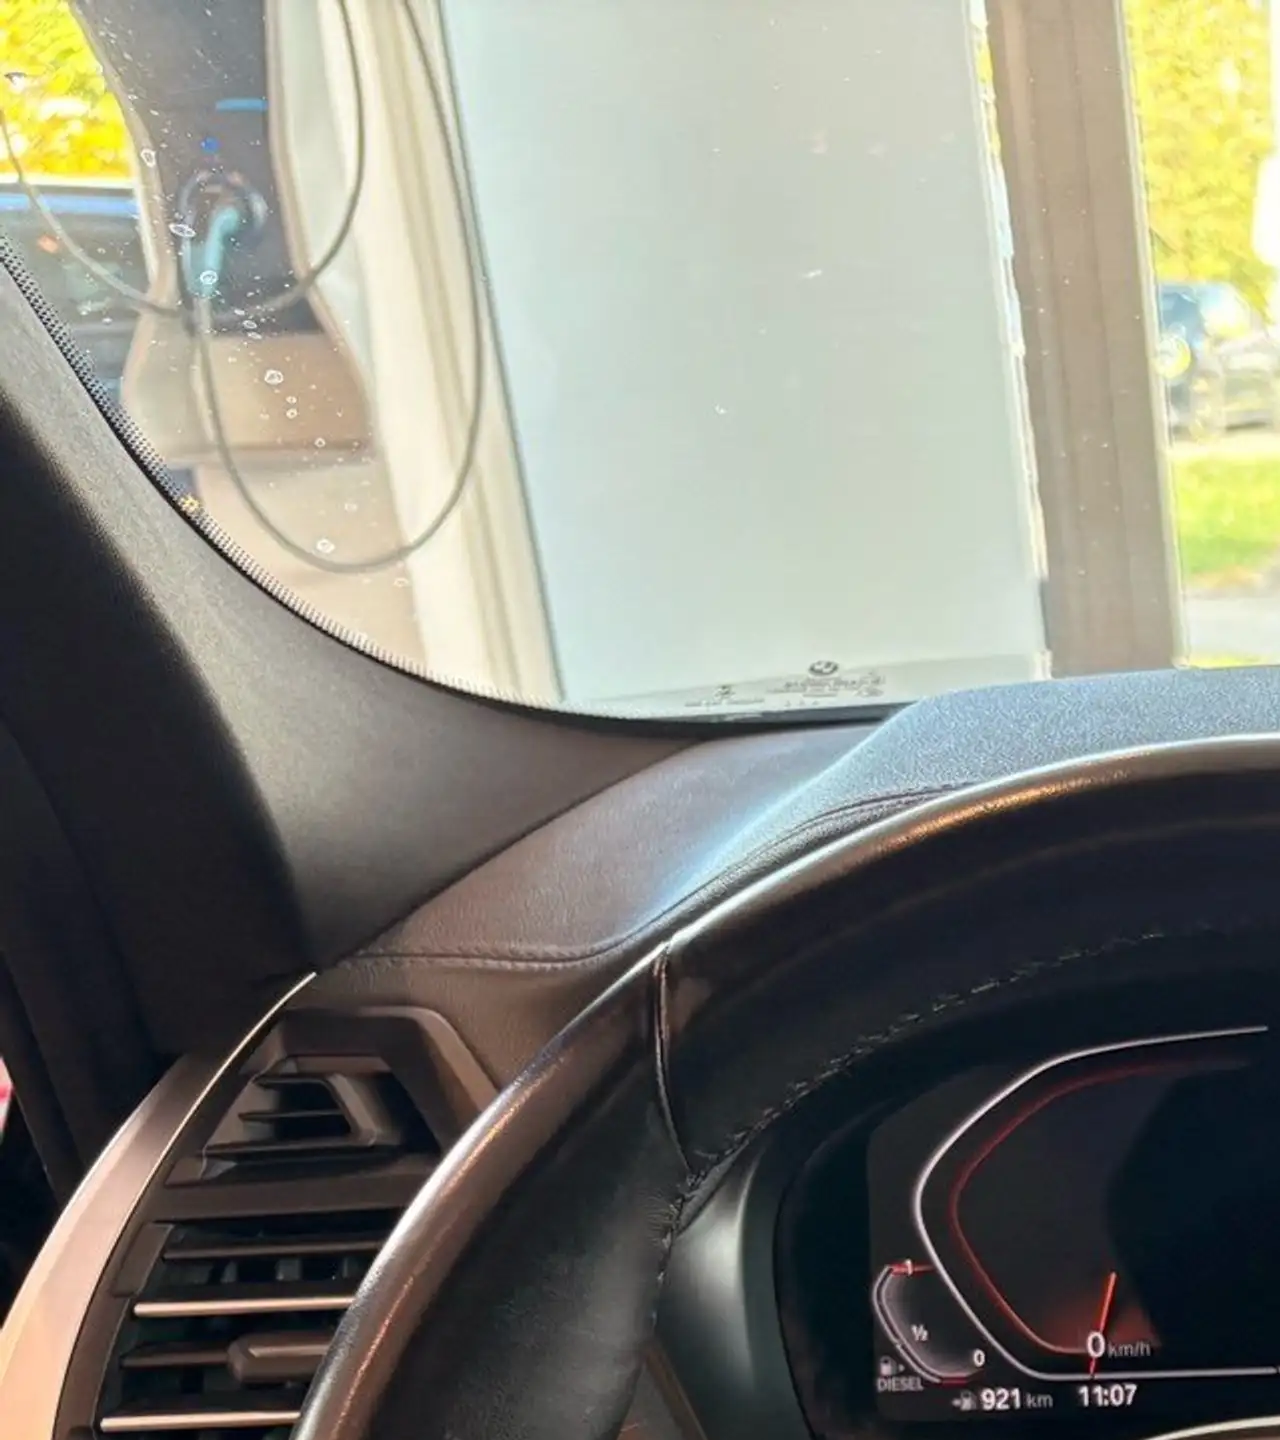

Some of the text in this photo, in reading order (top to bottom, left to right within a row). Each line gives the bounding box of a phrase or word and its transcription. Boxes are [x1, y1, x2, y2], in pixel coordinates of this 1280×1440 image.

[1086, 1331, 1105, 1358] 0
[973, 1350, 985, 1367] 0
[876, 1377, 925, 1392] DIESEL
[1078, 1383, 1139, 1408] 11:07
[980, 1387, 1054, 1412] 921 km
